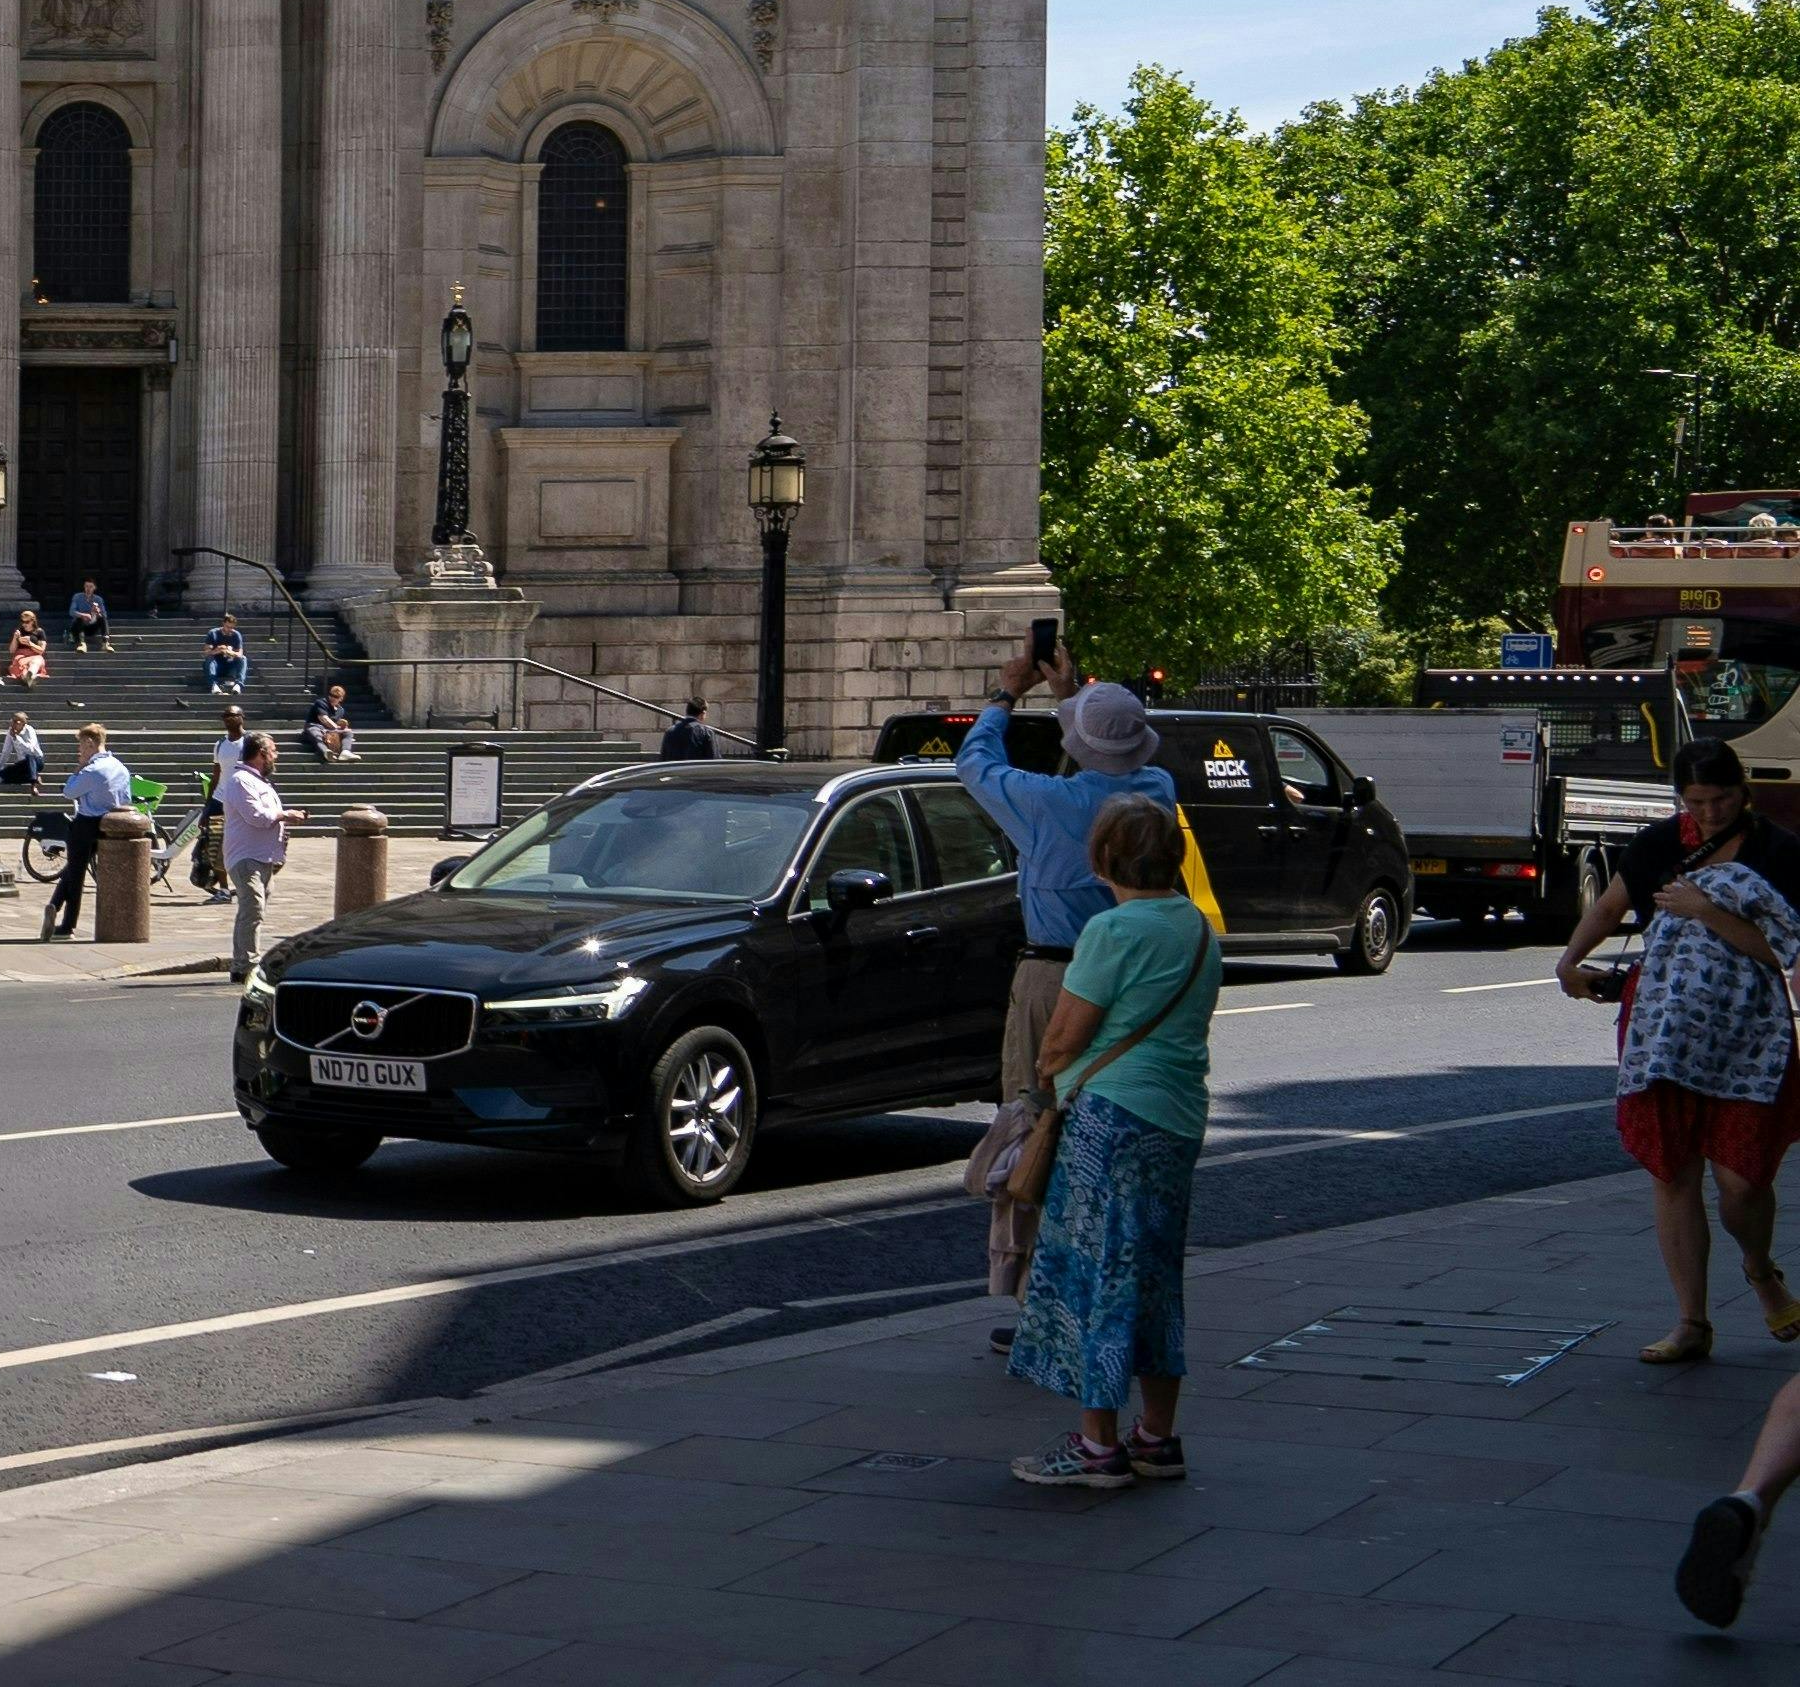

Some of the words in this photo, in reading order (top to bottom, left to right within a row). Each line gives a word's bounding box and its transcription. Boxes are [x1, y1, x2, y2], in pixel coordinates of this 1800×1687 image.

[1681, 590, 1703, 600] BIG
[1204, 760, 1248, 777] ROCK
[1208, 779, 1252, 789] COMPLIANCE
[318, 1058, 369, 1083] ND70
[374, 1063, 416, 1087] GUX
